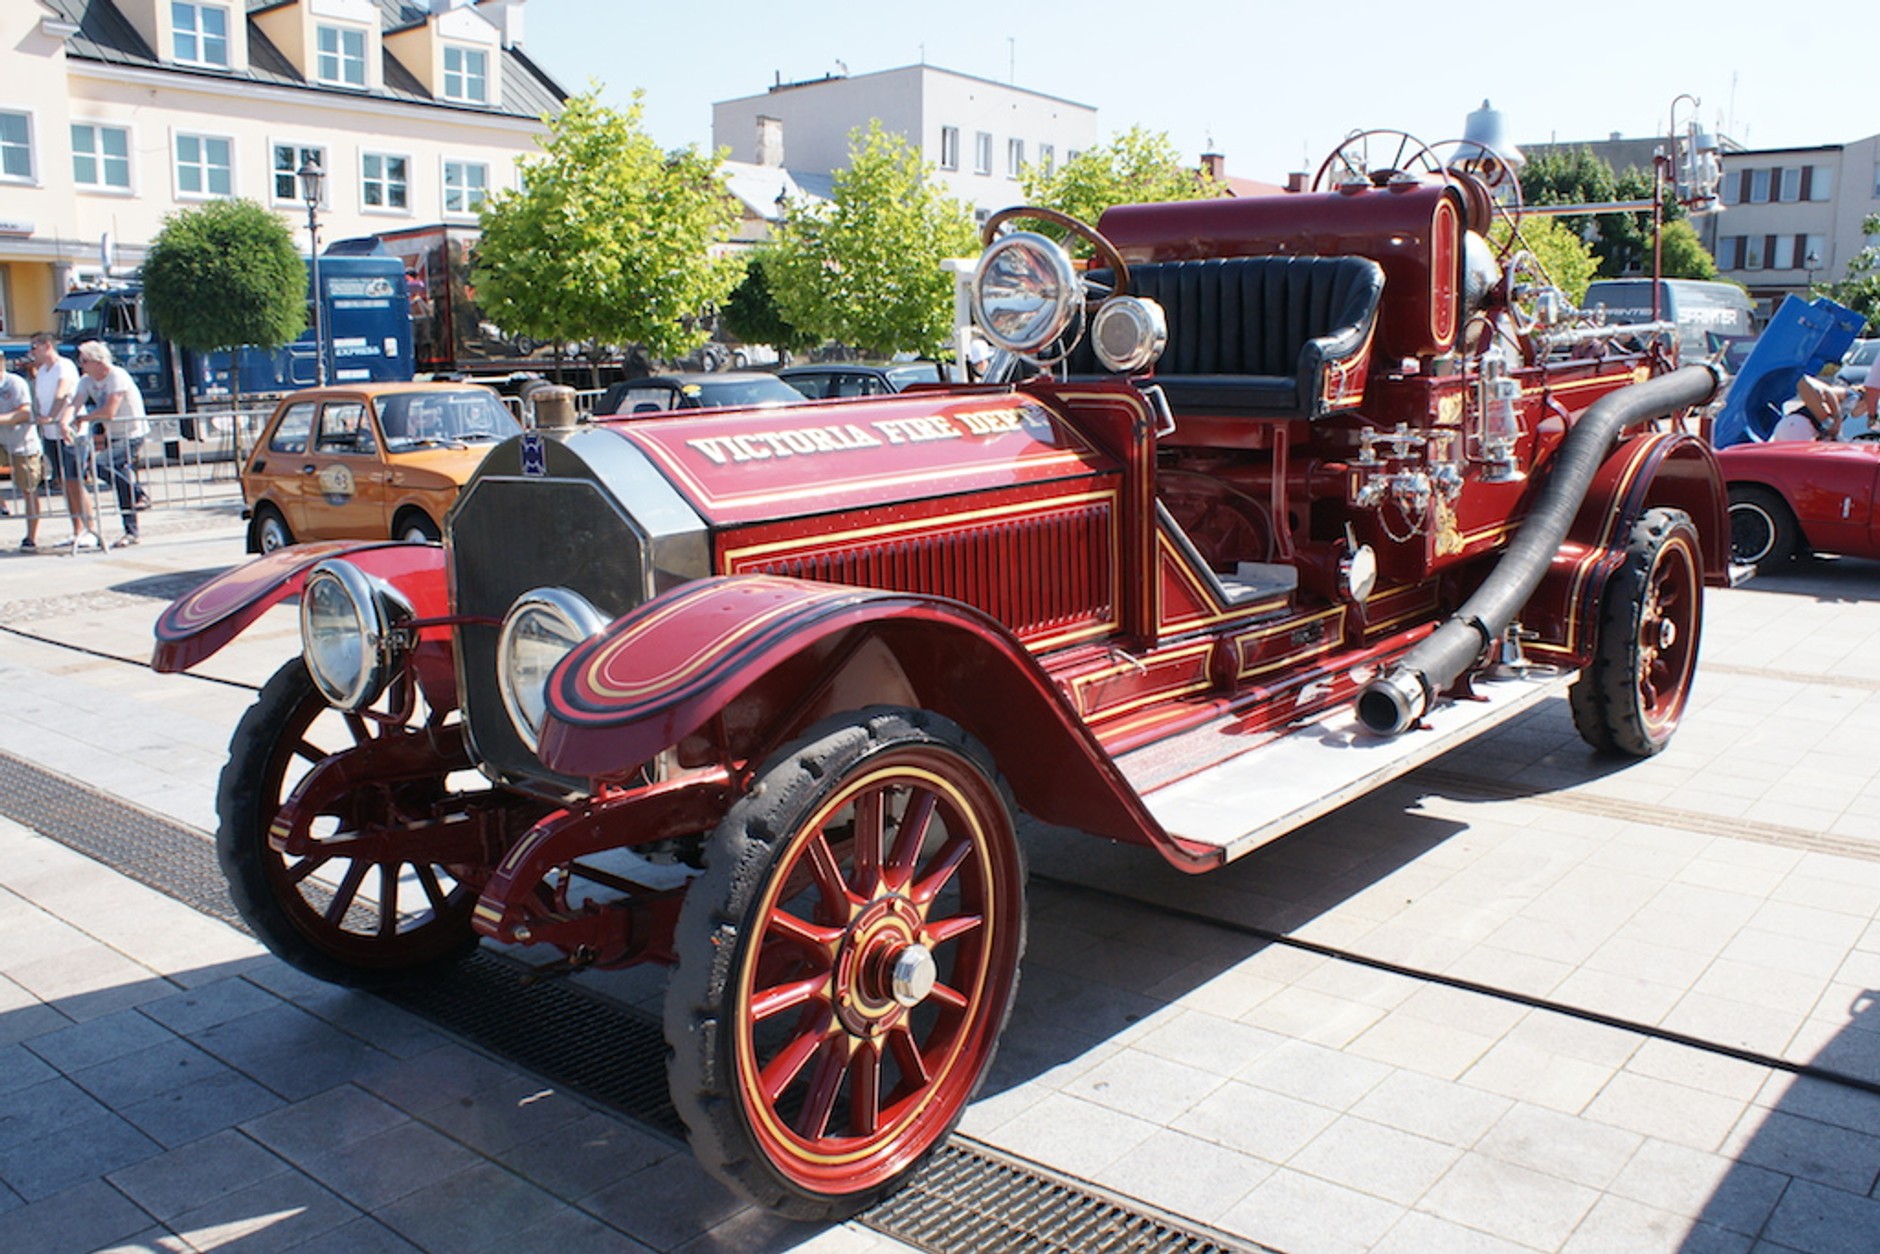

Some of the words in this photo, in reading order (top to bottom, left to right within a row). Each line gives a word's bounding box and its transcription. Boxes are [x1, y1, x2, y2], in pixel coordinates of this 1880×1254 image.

[1678, 307, 1737, 324] SPRINTER
[686, 424, 881, 464] VICTORIA
[871, 416, 962, 444] FIRE
